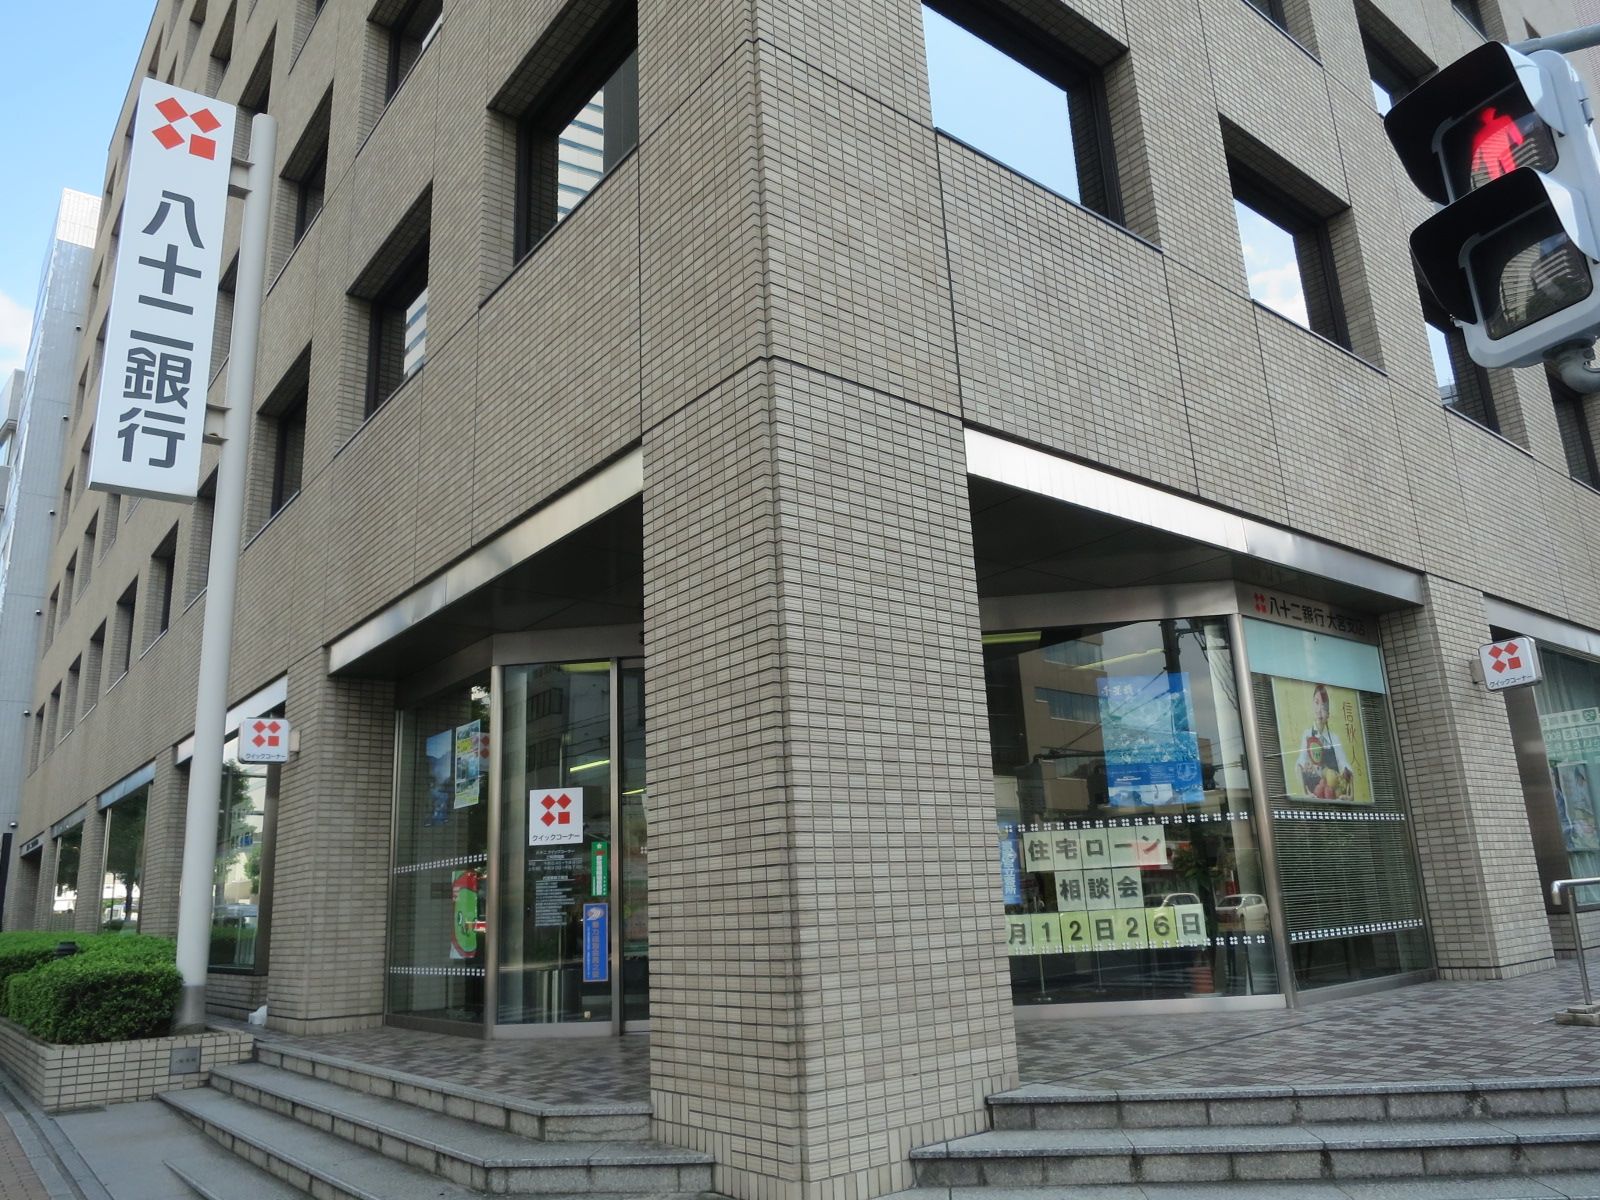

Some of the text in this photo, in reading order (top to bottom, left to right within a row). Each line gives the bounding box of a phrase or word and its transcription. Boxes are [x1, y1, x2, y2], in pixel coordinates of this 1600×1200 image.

[117, 189, 206, 469] 八十二銀行
[1269, 596, 1324, 627] 八十二銀行
[1489, 674, 1533, 688] クイックコーナー
[532, 833, 581, 842] クイックコーナー
[1027, 834, 1161, 863] 住宅ローン
[1059, 875, 1139, 901] 相談会
